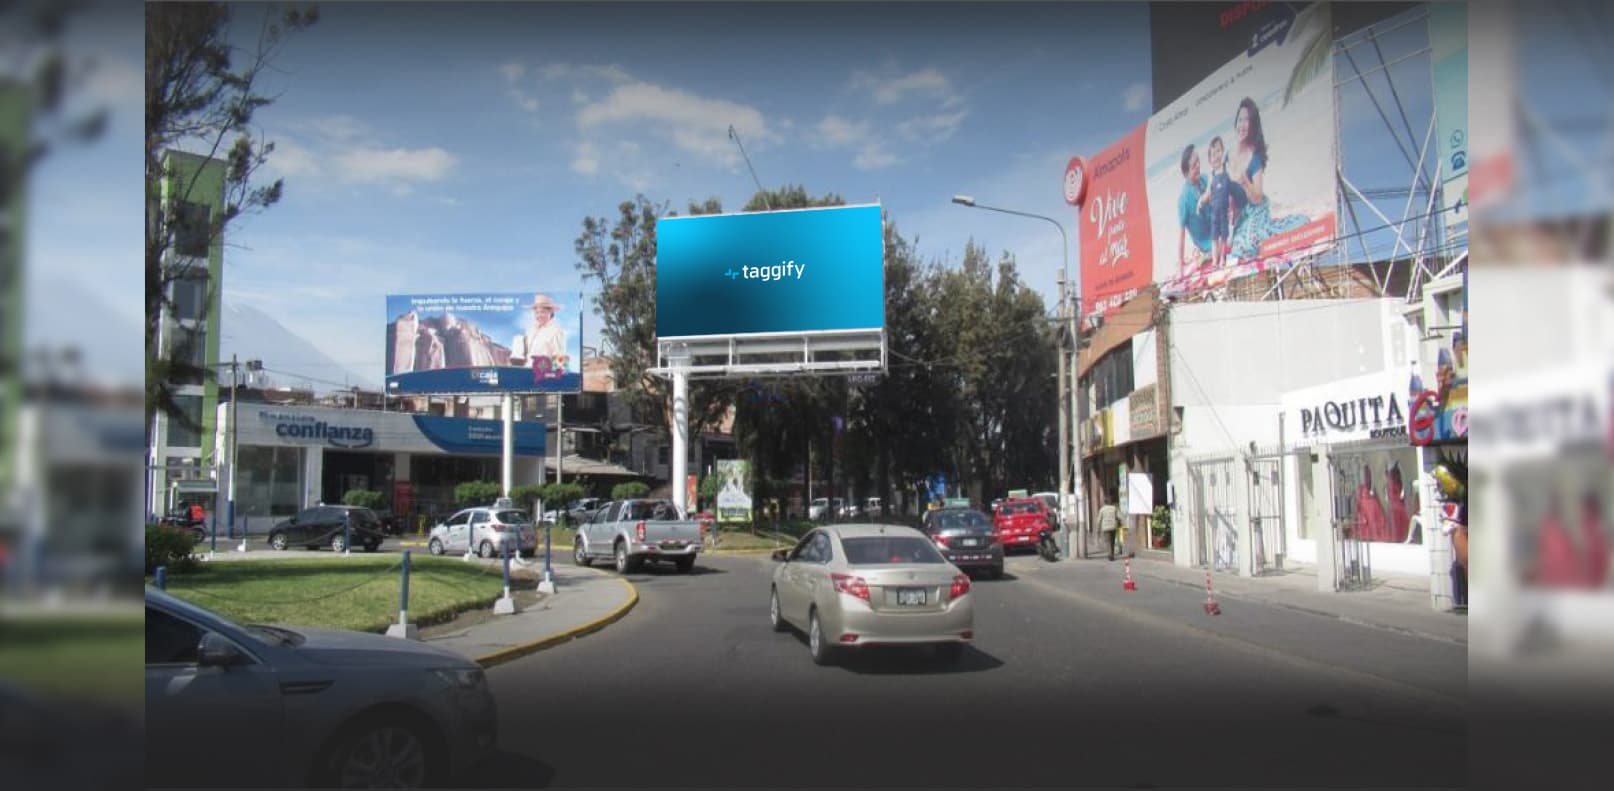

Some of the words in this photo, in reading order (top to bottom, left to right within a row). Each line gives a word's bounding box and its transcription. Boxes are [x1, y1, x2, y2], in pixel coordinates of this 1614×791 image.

[1090, 190, 1128, 238] Vive
[742, 260, 805, 281] taggify
[1300, 392, 1403, 433] PAQUITA
[275, 421, 373, 443] confianza
